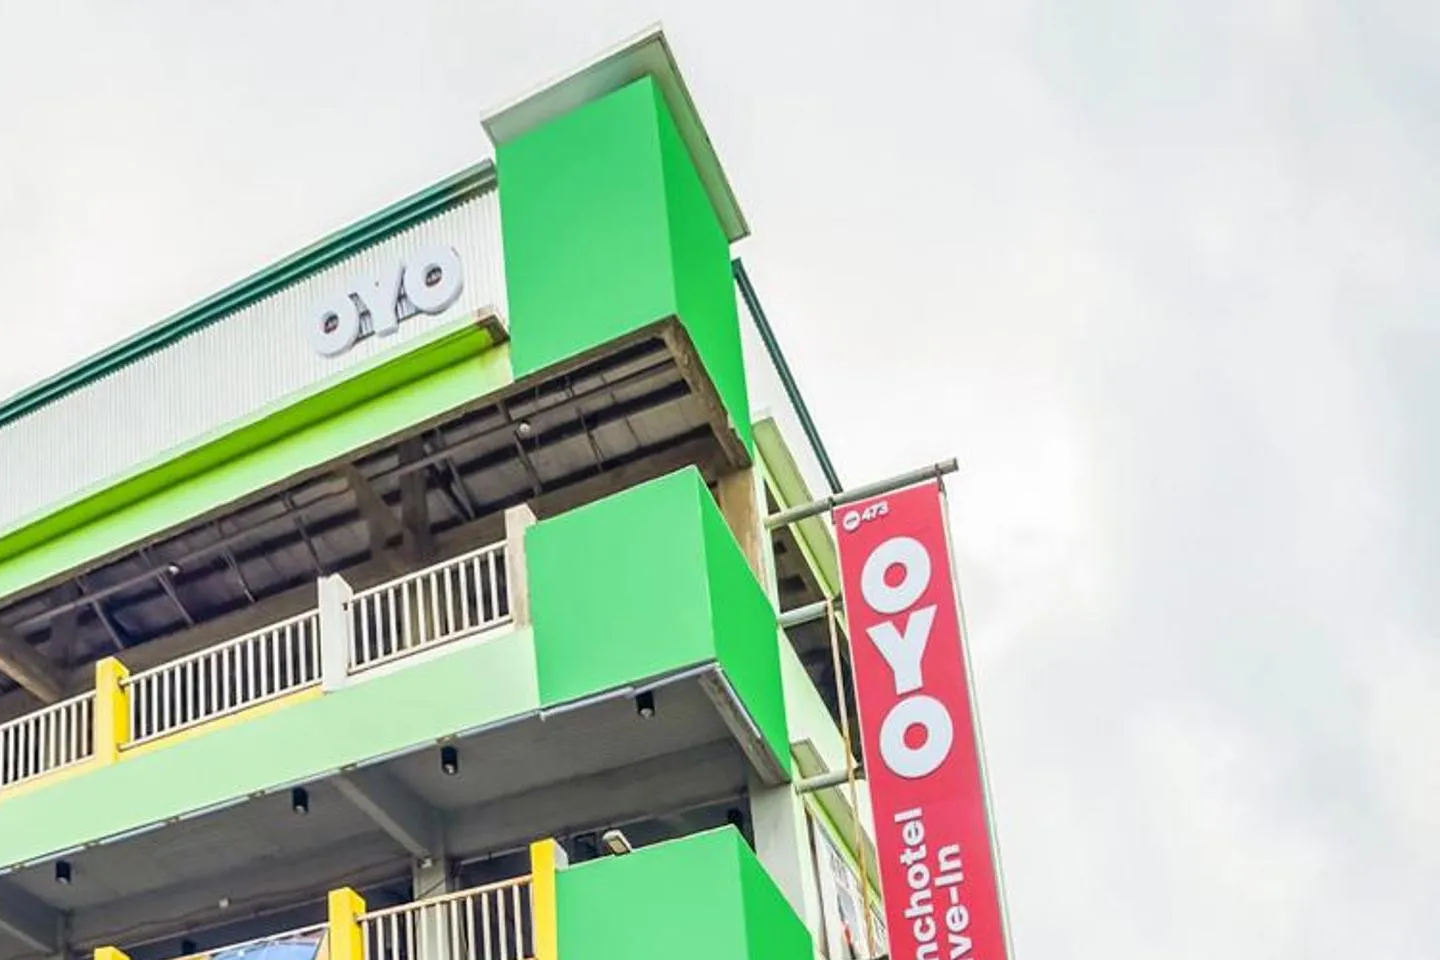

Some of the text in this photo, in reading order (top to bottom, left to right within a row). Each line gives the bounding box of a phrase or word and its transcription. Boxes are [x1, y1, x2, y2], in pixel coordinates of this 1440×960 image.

[311, 244, 463, 358] OYO
[861, 501, 889, 522] 473
[861, 536, 954, 778] OYO
